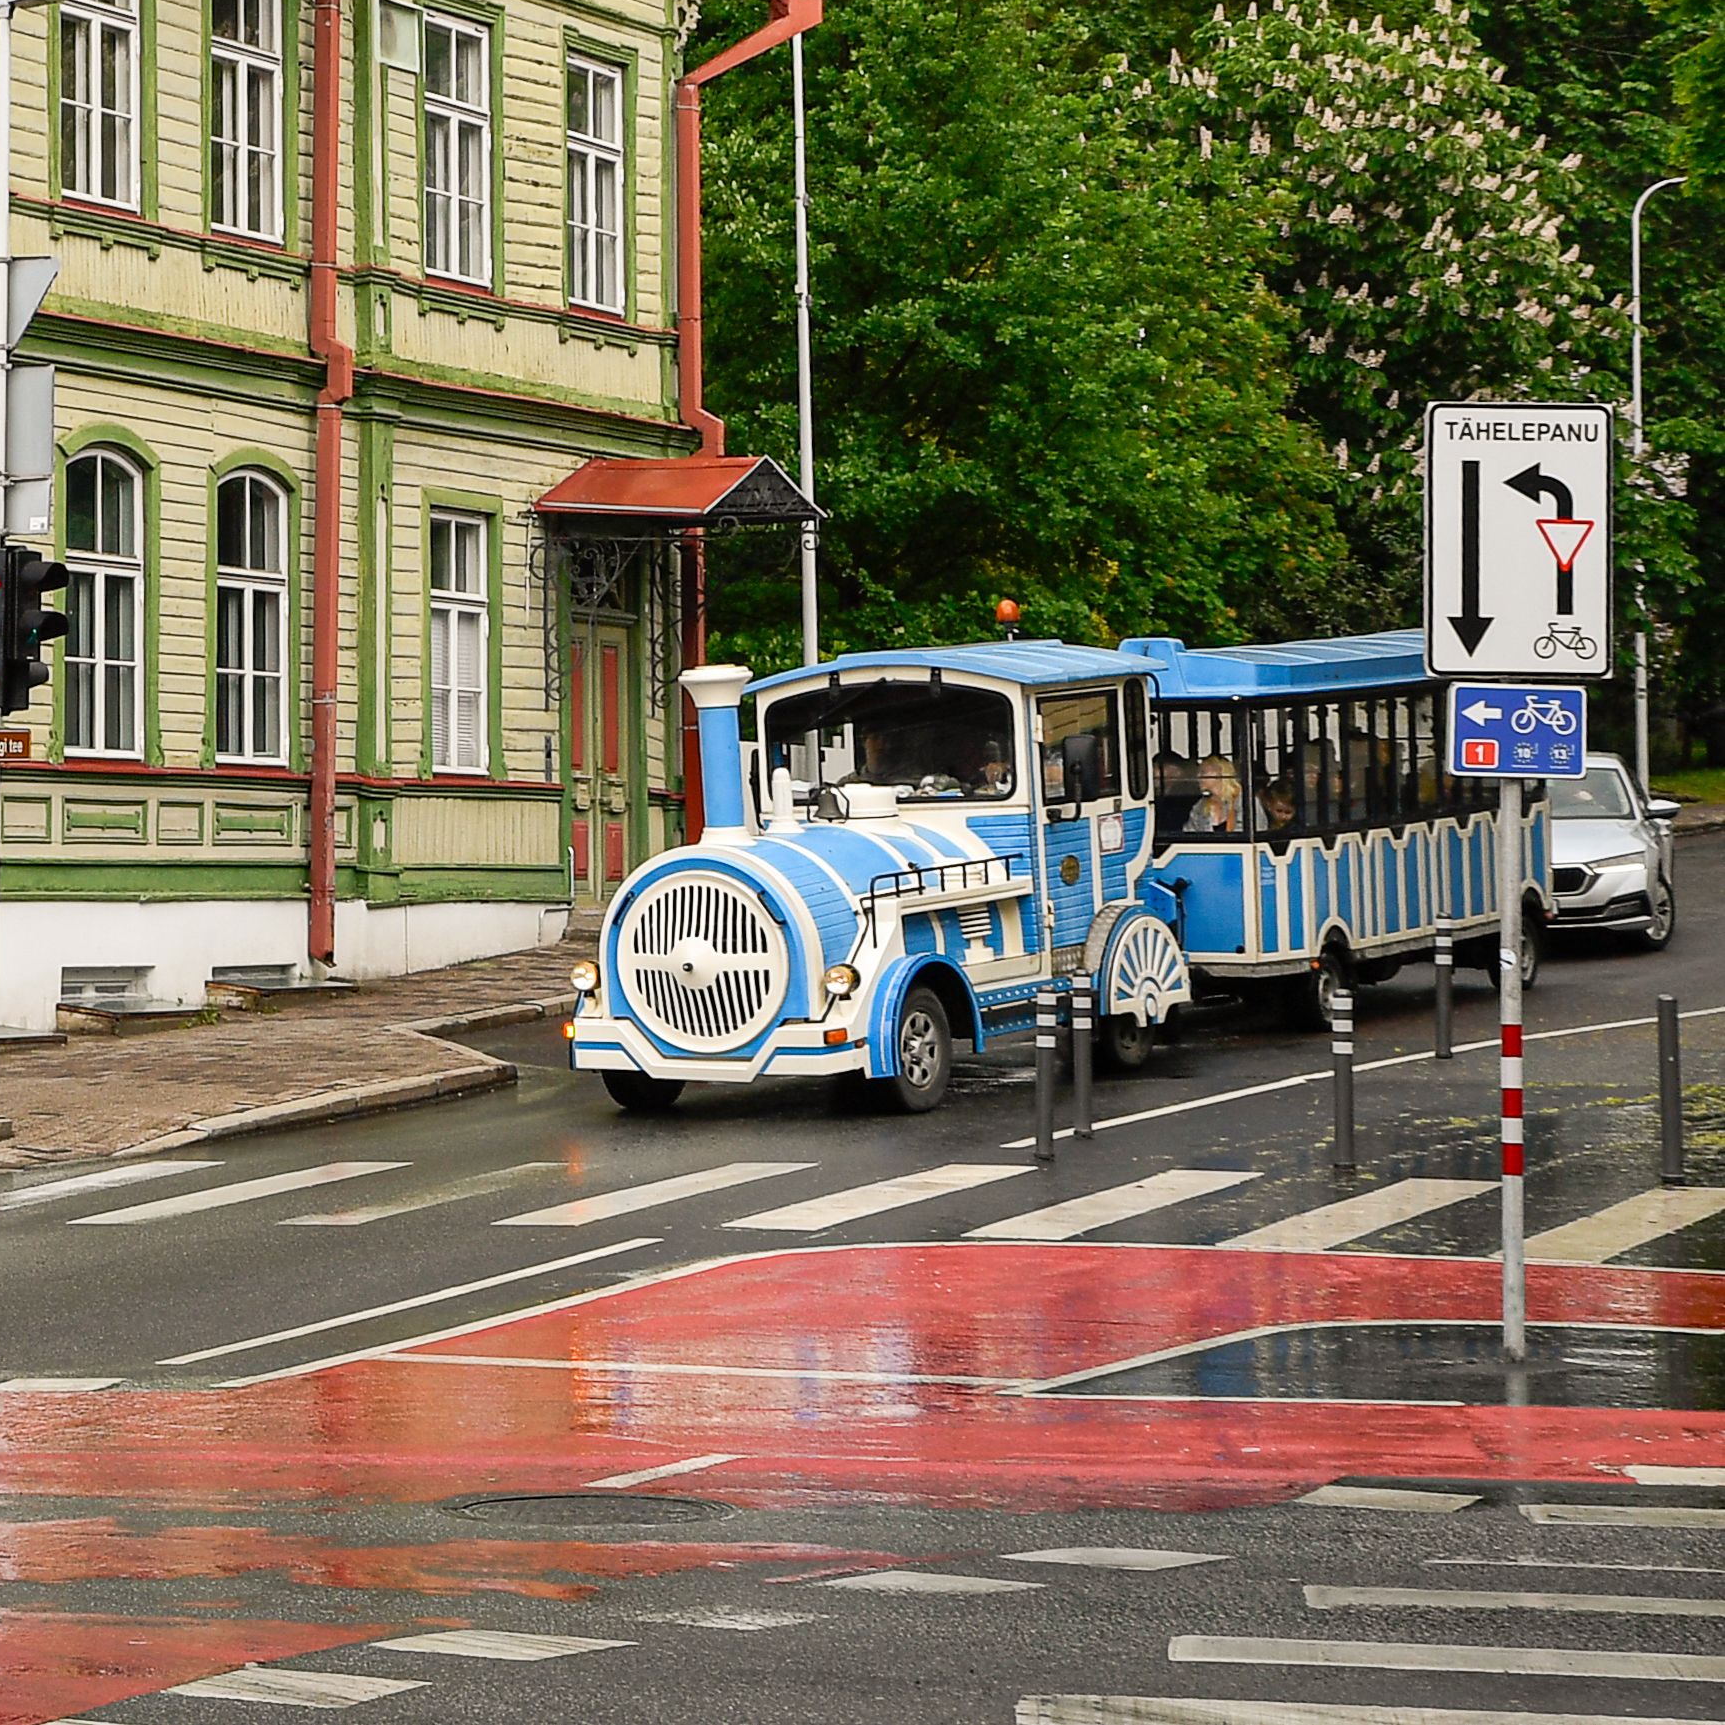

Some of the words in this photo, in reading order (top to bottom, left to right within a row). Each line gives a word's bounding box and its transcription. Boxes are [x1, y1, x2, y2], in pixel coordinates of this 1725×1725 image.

[1444, 417, 1599, 442] TÄHELEPANU
[9, 739, 23, 753] tee
[1474, 744, 1485, 763] 1
